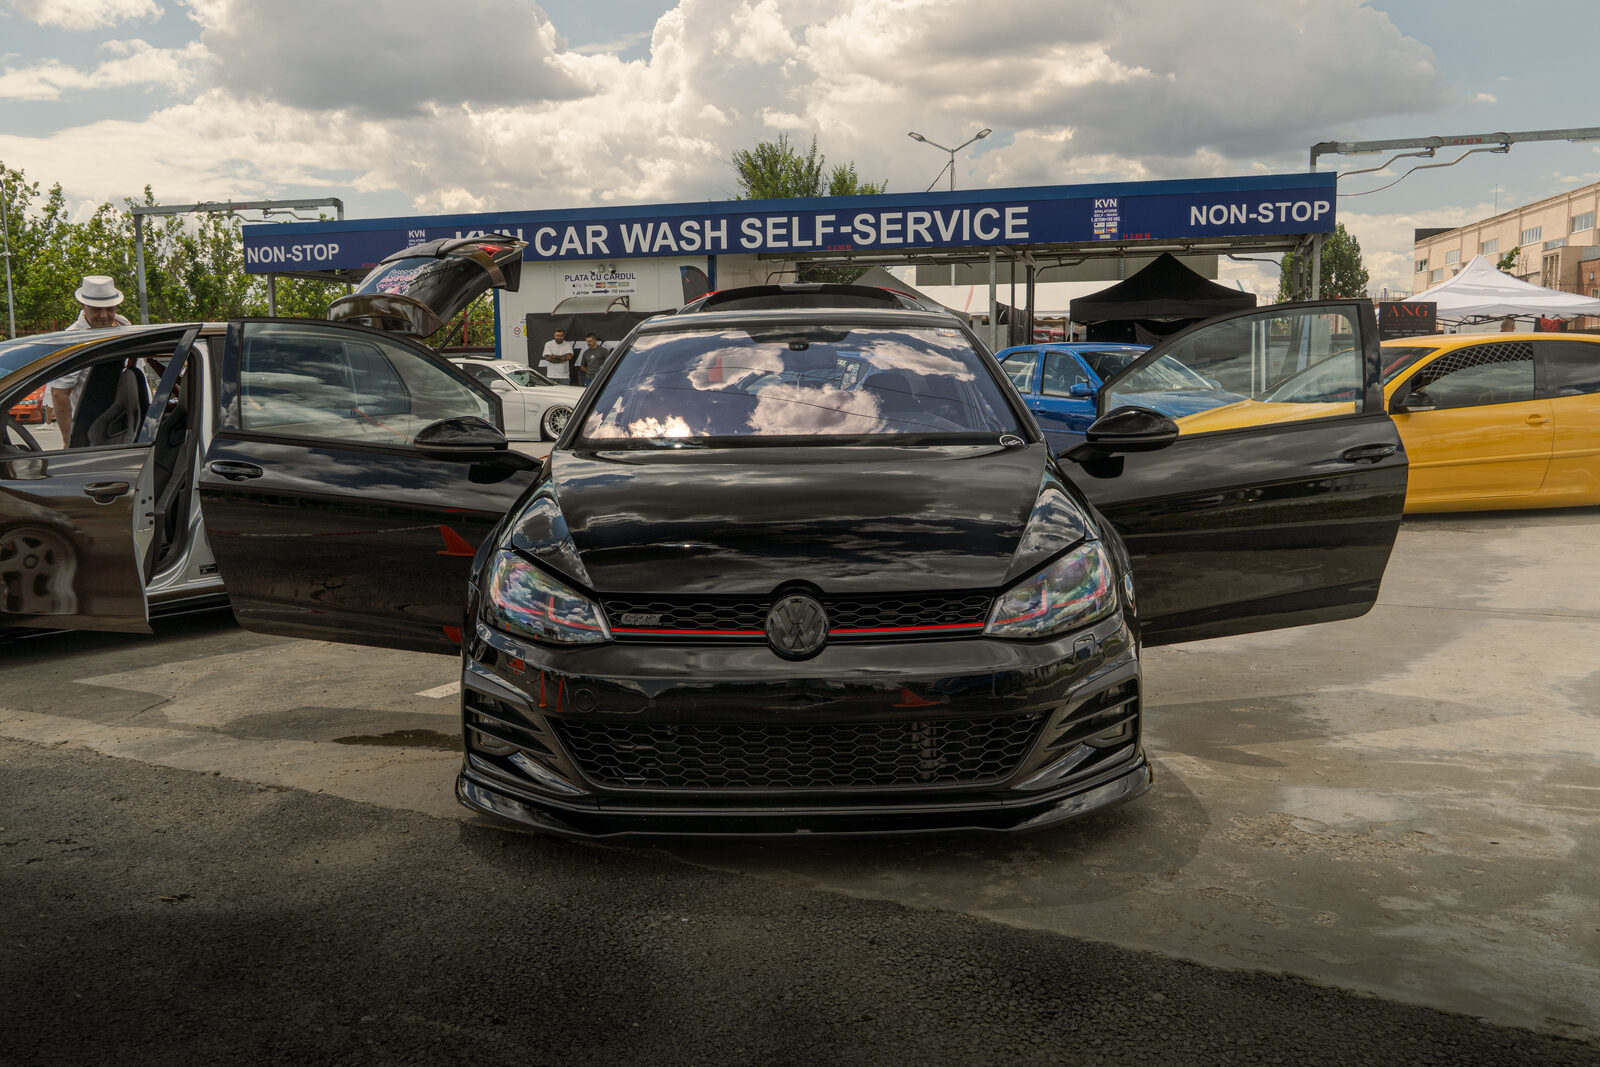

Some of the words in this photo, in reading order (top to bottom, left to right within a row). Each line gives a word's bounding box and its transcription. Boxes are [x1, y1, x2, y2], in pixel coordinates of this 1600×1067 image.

[1094, 198, 1117, 208] KVN
[1190, 200, 1330, 226] NON-STOP
[408, 229, 426, 239] KVN
[534, 225, 610, 257] CAR
[619, 219, 727, 253] WASH
[739, 206, 1030, 249] SELF-SERVICE
[247, 243, 339, 264] NON-STOP
[564, 274, 589, 282] PLATA
[590, 273, 602, 281] CU
[603, 272, 637, 281] CARDUL
[1387, 304, 1428, 318] ANG
